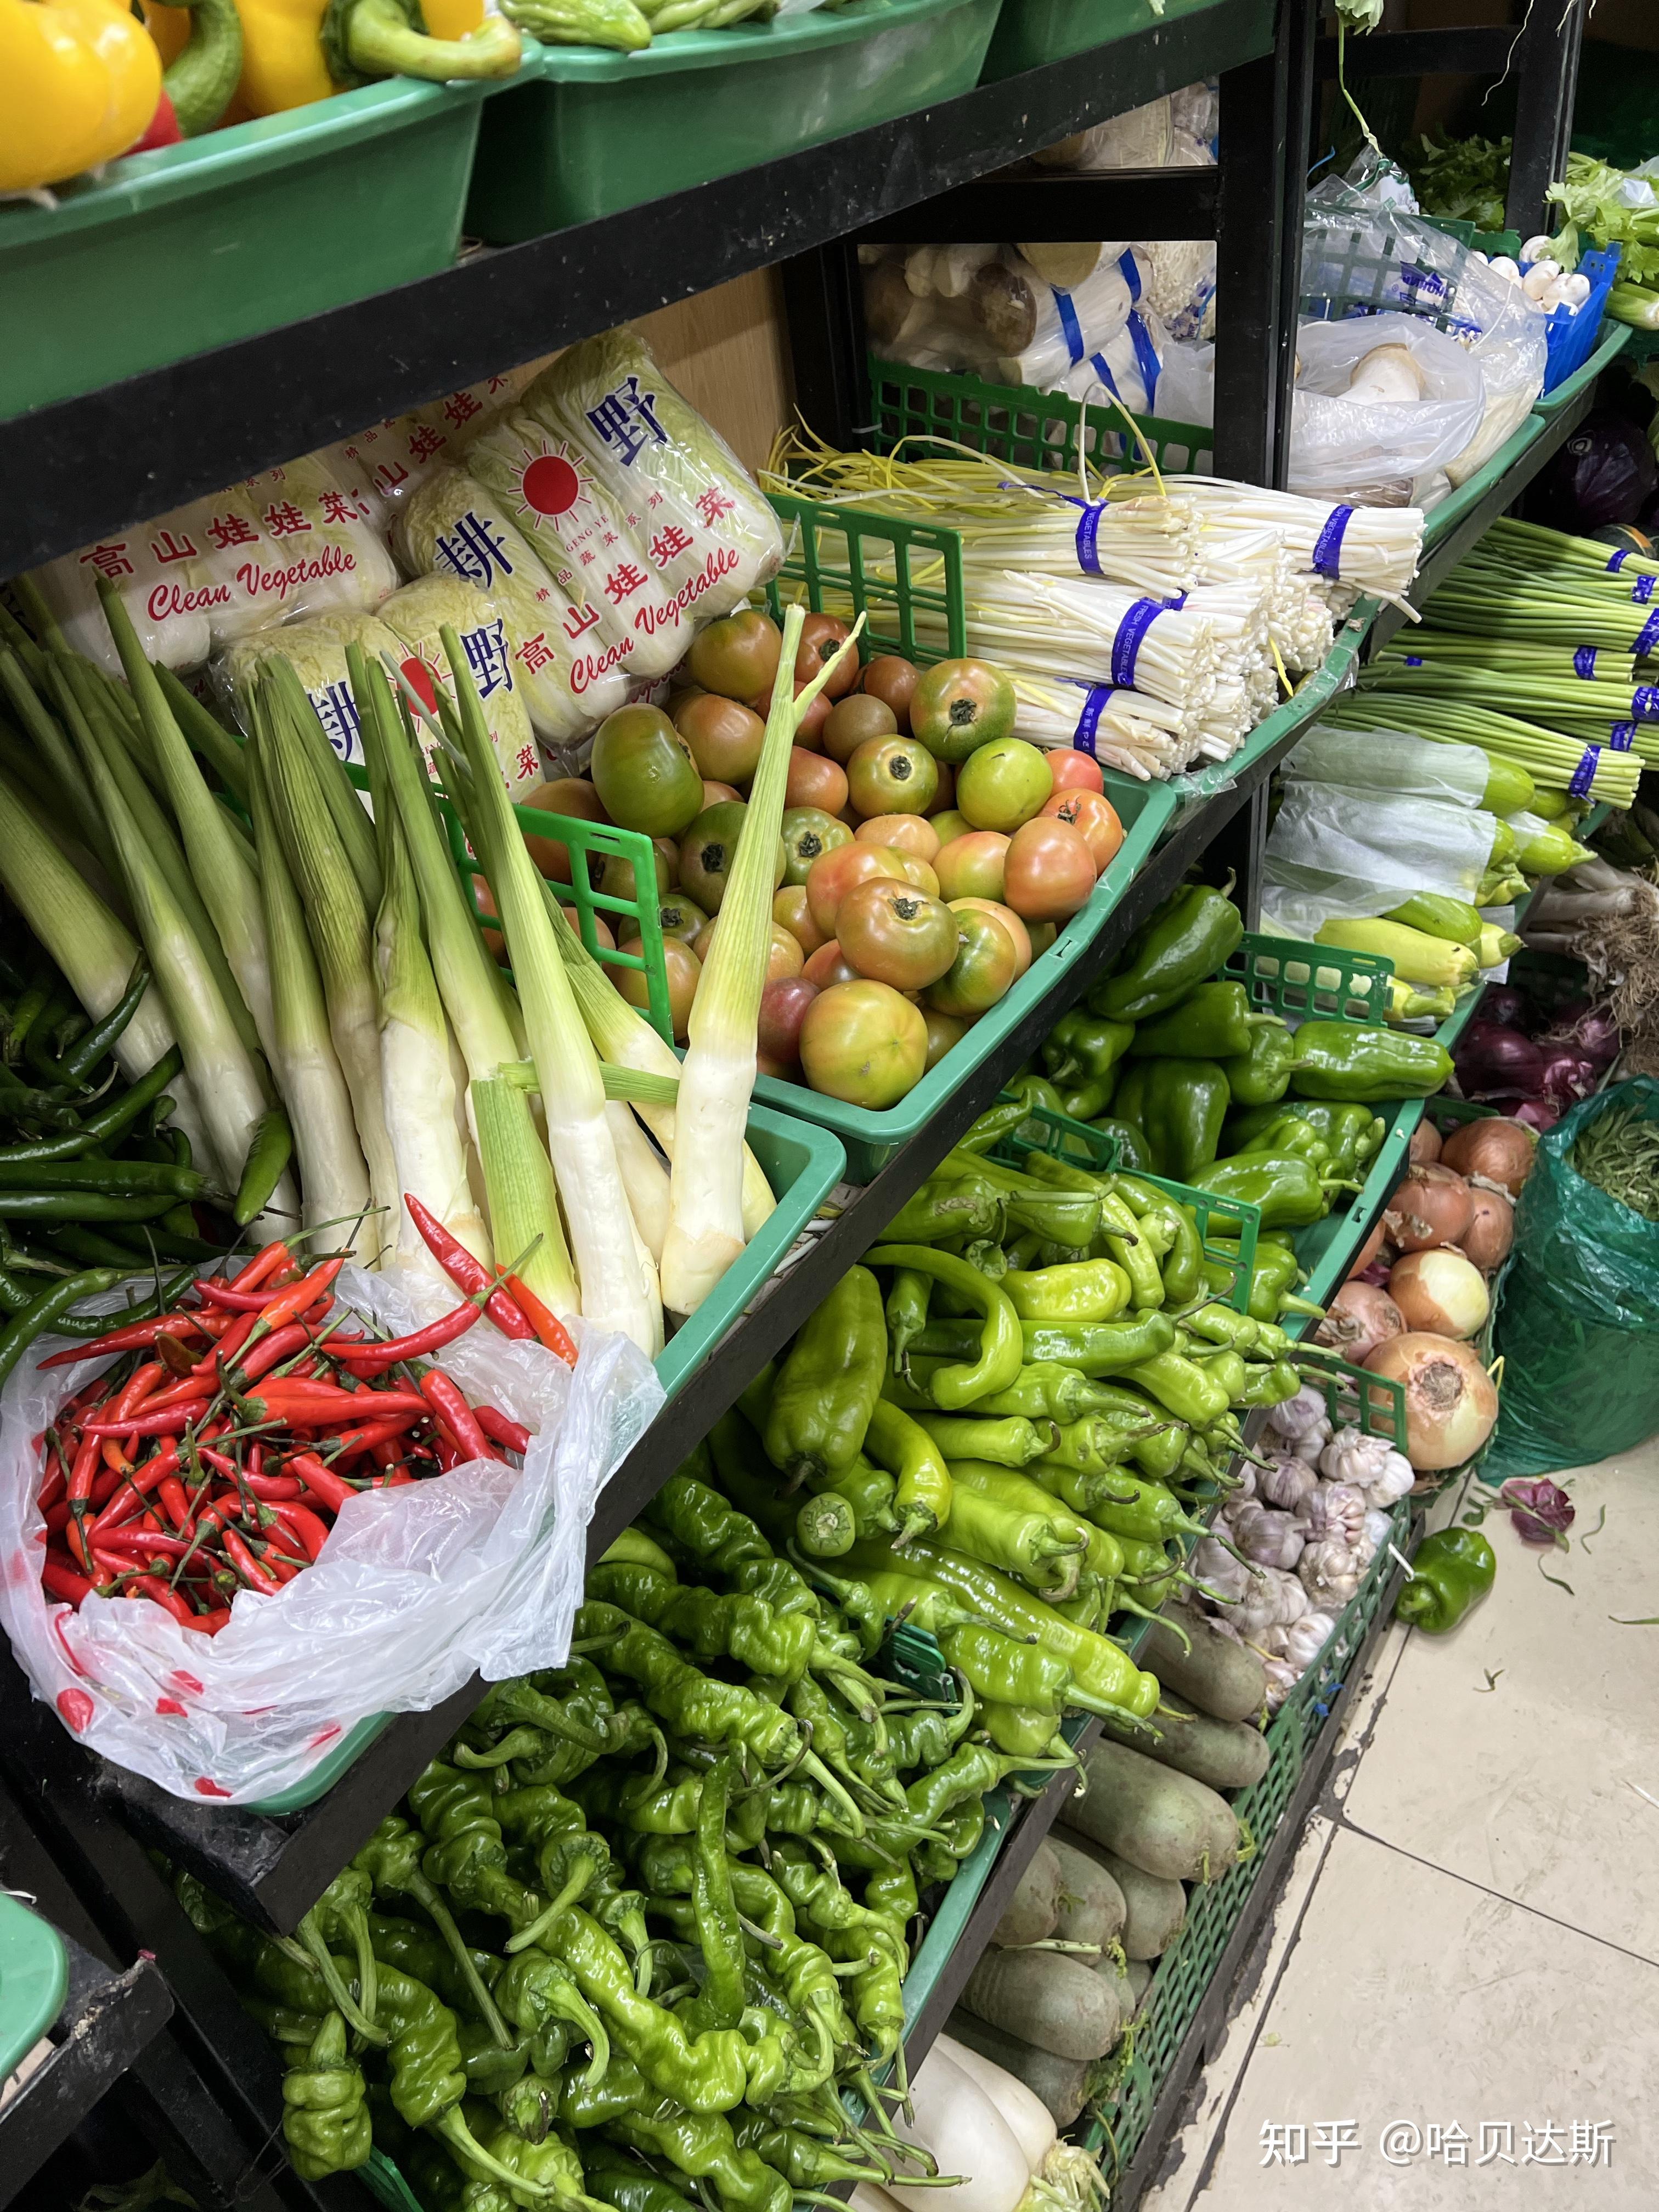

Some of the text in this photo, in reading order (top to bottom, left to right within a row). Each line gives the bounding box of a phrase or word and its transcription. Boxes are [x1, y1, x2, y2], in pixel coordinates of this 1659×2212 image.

[586, 377, 668, 466] 野
[80, 492, 358, 579] 高山娃娃菜
[435, 511, 513, 588] 耕
[535, 492, 663, 602] 精品蔬菜系列
[566, 514, 609, 552] GENG YE
[1083, 511, 1096, 560] VEGETABLES
[148, 545, 357, 622] Clean Vegetable
[515, 487, 735, 674] 高山娃娃菜
[570, 636, 634, 693] Clean
[635, 548, 739, 634] Vegetable
[1131, 605, 1149, 625] FRESH
[460, 618, 513, 698] 野
